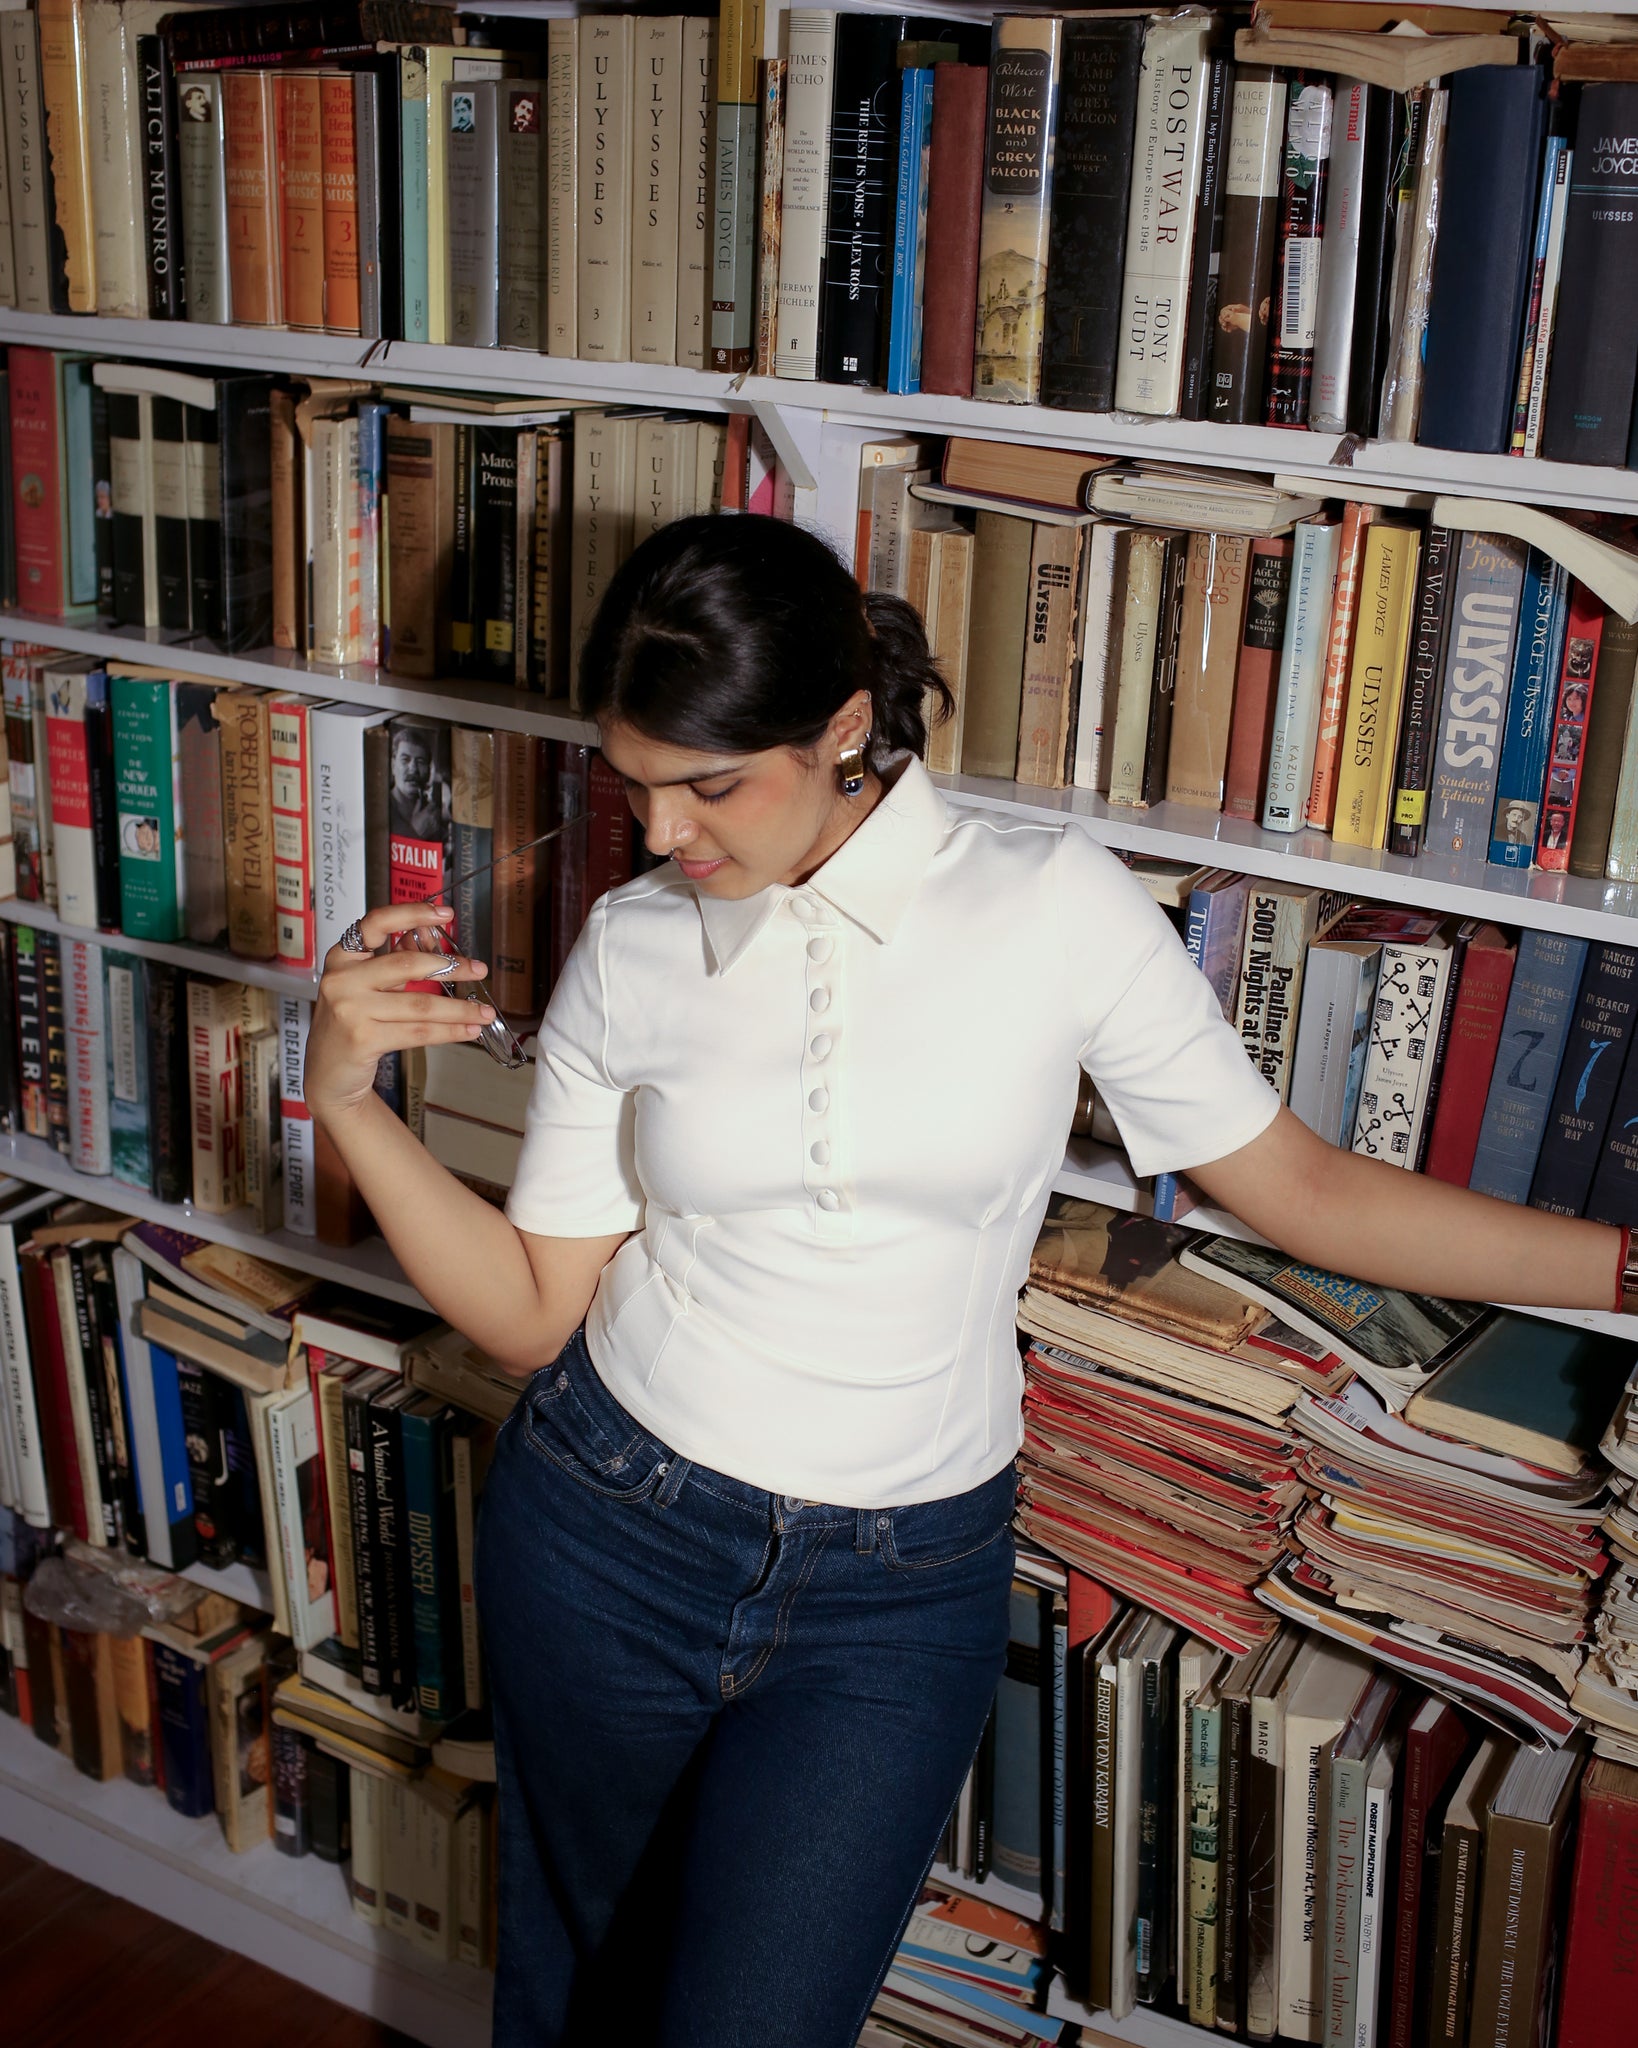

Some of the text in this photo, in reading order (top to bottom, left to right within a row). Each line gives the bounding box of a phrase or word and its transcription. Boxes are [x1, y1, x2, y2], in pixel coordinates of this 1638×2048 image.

[789, 54, 827, 66] TIME'S
[1073, 50, 1118, 64] BLACK
[790, 74, 824, 86] ECHO
[1073, 67, 1113, 80] LAMB
[1001, 84, 1037, 98] West
[1080, 84, 1106, 93] AND
[1152, 68, 1165, 115] History
[1236, 91, 1264, 101] ALICE
[994, 108, 1041, 120] BLACK
[1073, 97, 1110, 110] GREY
[1347, 86, 1360, 142] sarmad
[14, 44, 31, 193] ULYSSES
[996, 124, 1037, 135] LAMB
[1064, 112, 1118, 126] FALCON
[1151, 121, 1158, 132] of
[594, 56, 608, 225] ULYSSES
[648, 57, 664, 227] ULYSSES
[696, 58, 712, 230] ULYSSES
[1005, 137, 1028, 148] and
[1203, 59, 1223, 206] Susan Howe My Emily Dickinson
[995, 151, 1036, 165] GREY
[1066, 153, 1108, 163] REBECCA
[1147, 134, 1157, 181] Europe
[1156, 64, 1192, 245] POSTWAR
[1592, 158, 1638, 174] JOYCE
[146, 63, 167, 275] ALICE MUNRO
[990, 166, 1040, 179] FALCON
[1072, 163, 1100, 174] WEST
[895, 92, 913, 278] NATIONAL GALLERY BIRTHDAY BOOK
[718, 138, 733, 271] JAMES JOYCE
[848, 98, 871, 301] THE REST IS NOISE ALEX ROSS
[1143, 186, 1153, 221] Since
[242, 216, 248, 236] 1
[296, 216, 304, 237] 2
[1592, 211, 1633, 222] ULYSSES
[341, 220, 352, 241] 3
[1140, 226, 1149, 253] 1945
[593, 309, 600, 320] 3
[693, 314, 700, 326] 2
[1130, 295, 1149, 361] JUDT
[1151, 299, 1171, 363] TONY
[1528, 307, 1549, 439] Raymond Depardon Paysans
[457, 505, 465, 553] PROUST
[585, 452, 602, 598] ULYSSES
[1194, 544, 1243, 562] JOYCE
[1305, 533, 1315, 559] THE
[1191, 561, 1241, 584] ULYS
[1467, 549, 1517, 571] Joyce
[1199, 589, 1229, 605] SES
[1298, 567, 1312, 631] REMAINS
[1374, 544, 1393, 636] JAMES JOYCE
[1408, 528, 1447, 727] The World of Proust
[1134, 622, 1149, 662] Ulysses
[1295, 637, 1302, 655] OF
[1320, 548, 1360, 750] NUREYEV
[1444, 592, 1515, 770] ULYSSES
[1355, 666, 1383, 768] ULYSSES
[272, 729, 298, 743] STALIN
[123, 770, 149, 782] NEW
[1269, 730, 1284, 801] ISHIGURO
[1285, 745, 1299, 792] KAZUO
[117, 782, 158, 798] YORKER
[282, 786, 287, 803] 1
[1312, 771, 1323, 813] Dutton
[1438, 775, 1491, 792] Student's
[1440, 788, 1485, 805] Edition
[225, 751, 240, 844] Ian Hamilton
[238, 704, 262, 897] ROBERT LOWELL
[320, 764, 334, 921] EMILY DICKINSON
[609, 813, 624, 857] THE
[391, 842, 438, 870] STALIN
[394, 888, 409, 897] FOR
[399, 878, 426, 889] WAITING
[1533, 950, 1566, 965] PROUST
[1536, 935, 1568, 954] MARCEL
[1601, 949, 1636, 967] MARCEL
[1242, 897, 1277, 1039] 5001 Nights at
[1599, 962, 1633, 978] PROUST
[1265, 965, 1293, 1043] Pauline
[1586, 992, 1629, 1013] IN SEARCH
[1598, 1010, 1610, 1022] OF
[17, 952, 42, 1081] HITLER
[44, 955, 66, 1092] HITLER
[1580, 1017, 1622, 1037] LOST TIME
[73, 942, 93, 1150] REPORTING DAVID REMNICK
[283, 1000, 300, 1098] THE DEADLINE
[1319, 1002, 1335, 1082] James Joyce Ulysses
[1558, 1114, 1595, 1130] SWANN'S
[1564, 1128, 1583, 1142] WAY
[286, 1123, 304, 1209] JILL LEPORE
[1550, 1201, 1575, 1216] FOLIO
[180, 1380, 203, 1396] JAZZ
[372, 1421, 397, 1547] A Vanished World
[408, 1510, 436, 1597] ODYSSEY
[1094, 1680, 1111, 1829] HERBERT VON KARAJAN
[1336, 1772, 1350, 1809] Liebling
[1303, 1745, 1320, 1942] The Museum of Modern Art, New York
[1366, 1802, 1378, 1898] ROBERT MAPPLETHORPE
[1331, 1817, 1357, 2037] The Dickinsons of Amherst
